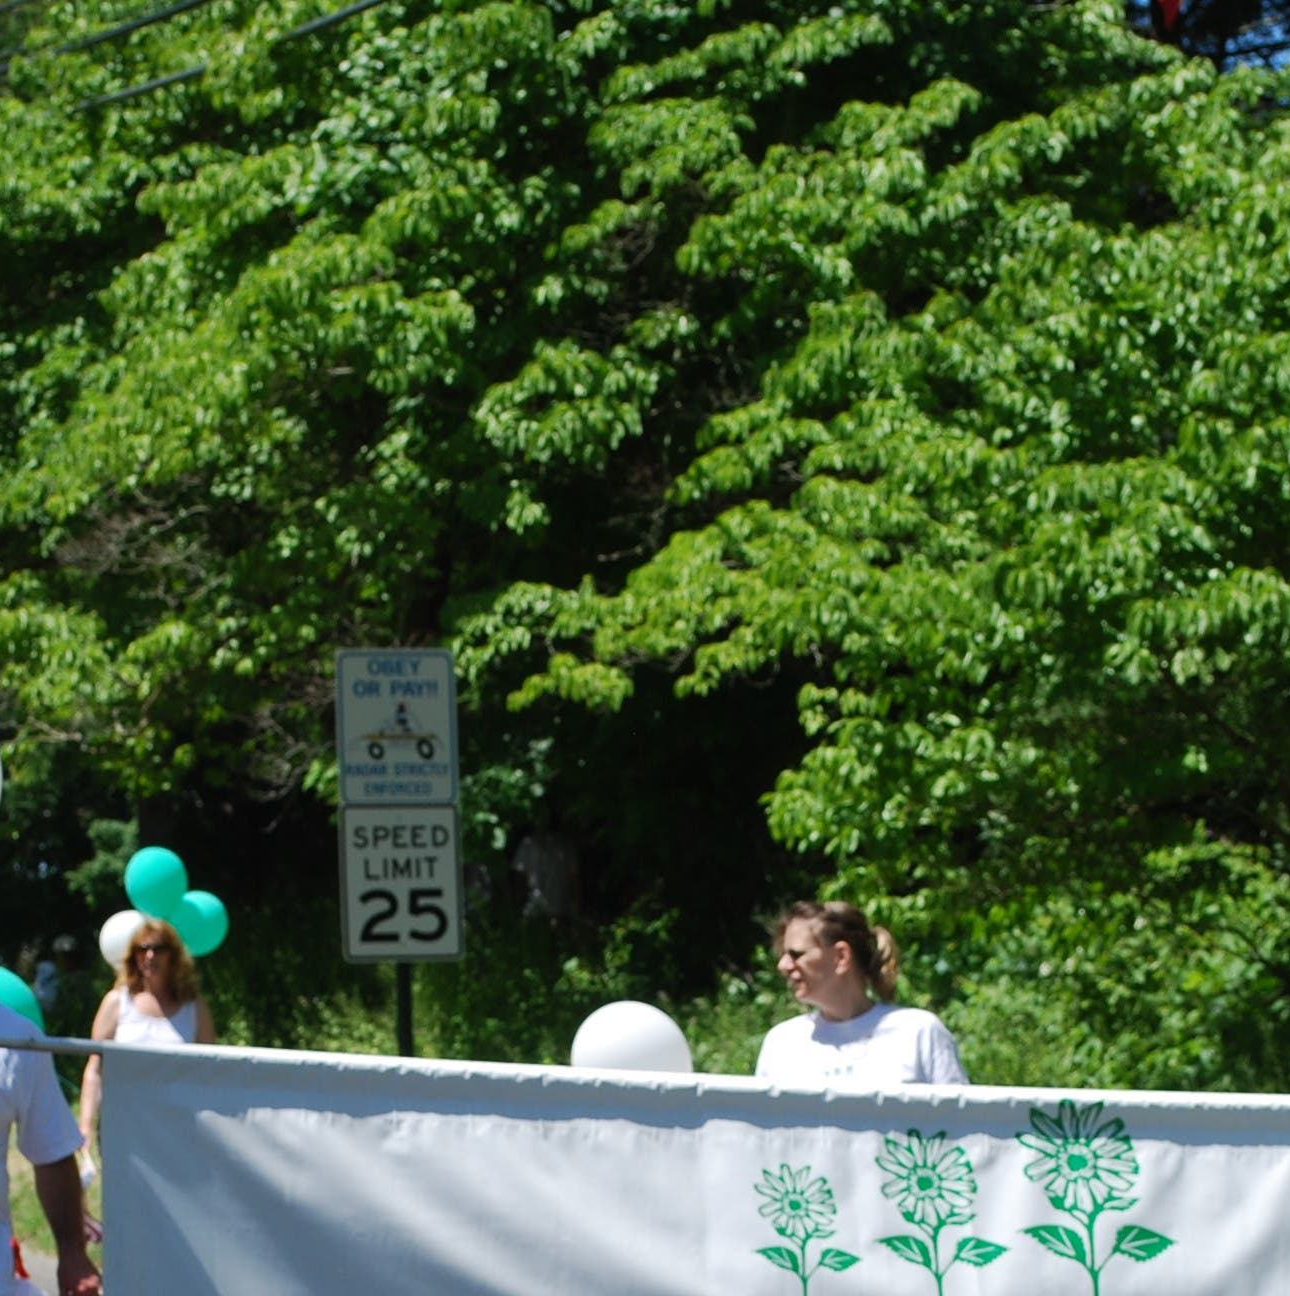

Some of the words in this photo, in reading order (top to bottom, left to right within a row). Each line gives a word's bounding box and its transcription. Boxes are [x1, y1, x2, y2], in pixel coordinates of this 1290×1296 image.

[367, 657, 421, 676] OBEY
[352, 680, 380, 697] OR
[352, 825, 449, 849] SPEED
[363, 857, 438, 880] LIMIT
[359, 889, 448, 942] 25
